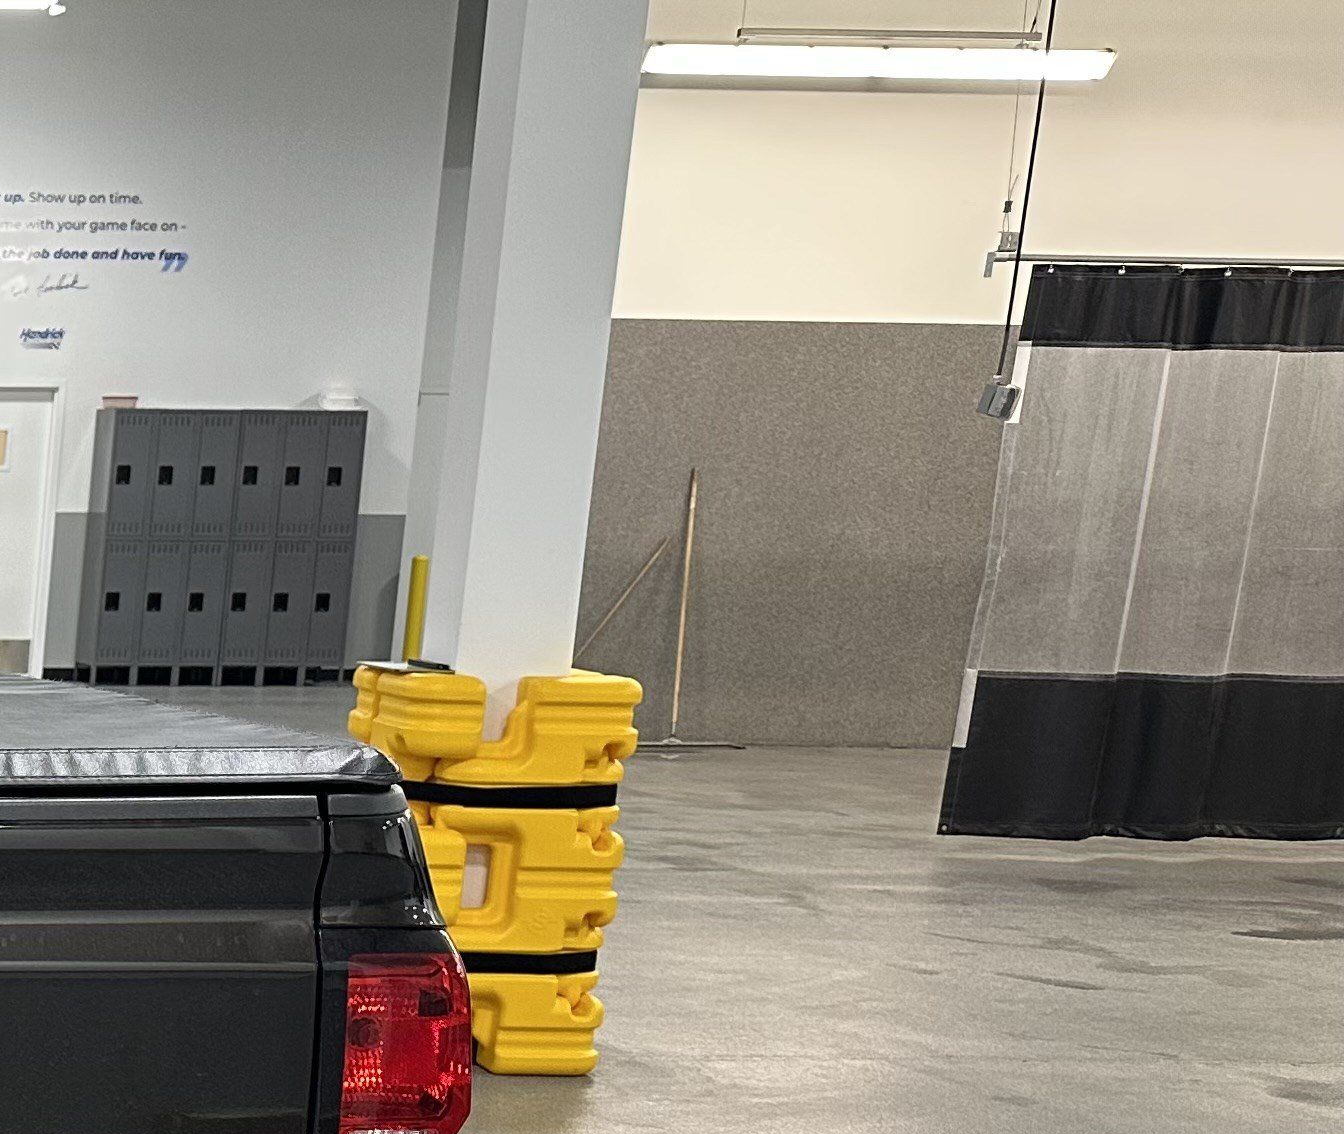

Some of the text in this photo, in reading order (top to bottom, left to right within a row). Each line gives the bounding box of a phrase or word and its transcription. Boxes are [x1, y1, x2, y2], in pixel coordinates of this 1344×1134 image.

[28, 191, 66, 202] Show
[68, 194, 87, 205] up
[88, 194, 106, 204] on
[108, 191, 143, 205] time.
[25, 219, 55, 232] with
[57, 221, 88, 234] your
[89, 222, 129, 234] game
[130, 219, 158, 231] face
[160, 222, 179, 232] on
[53, 248, 89, 260] done
[90, 248, 119, 260] and
[120, 249, 158, 261] have
